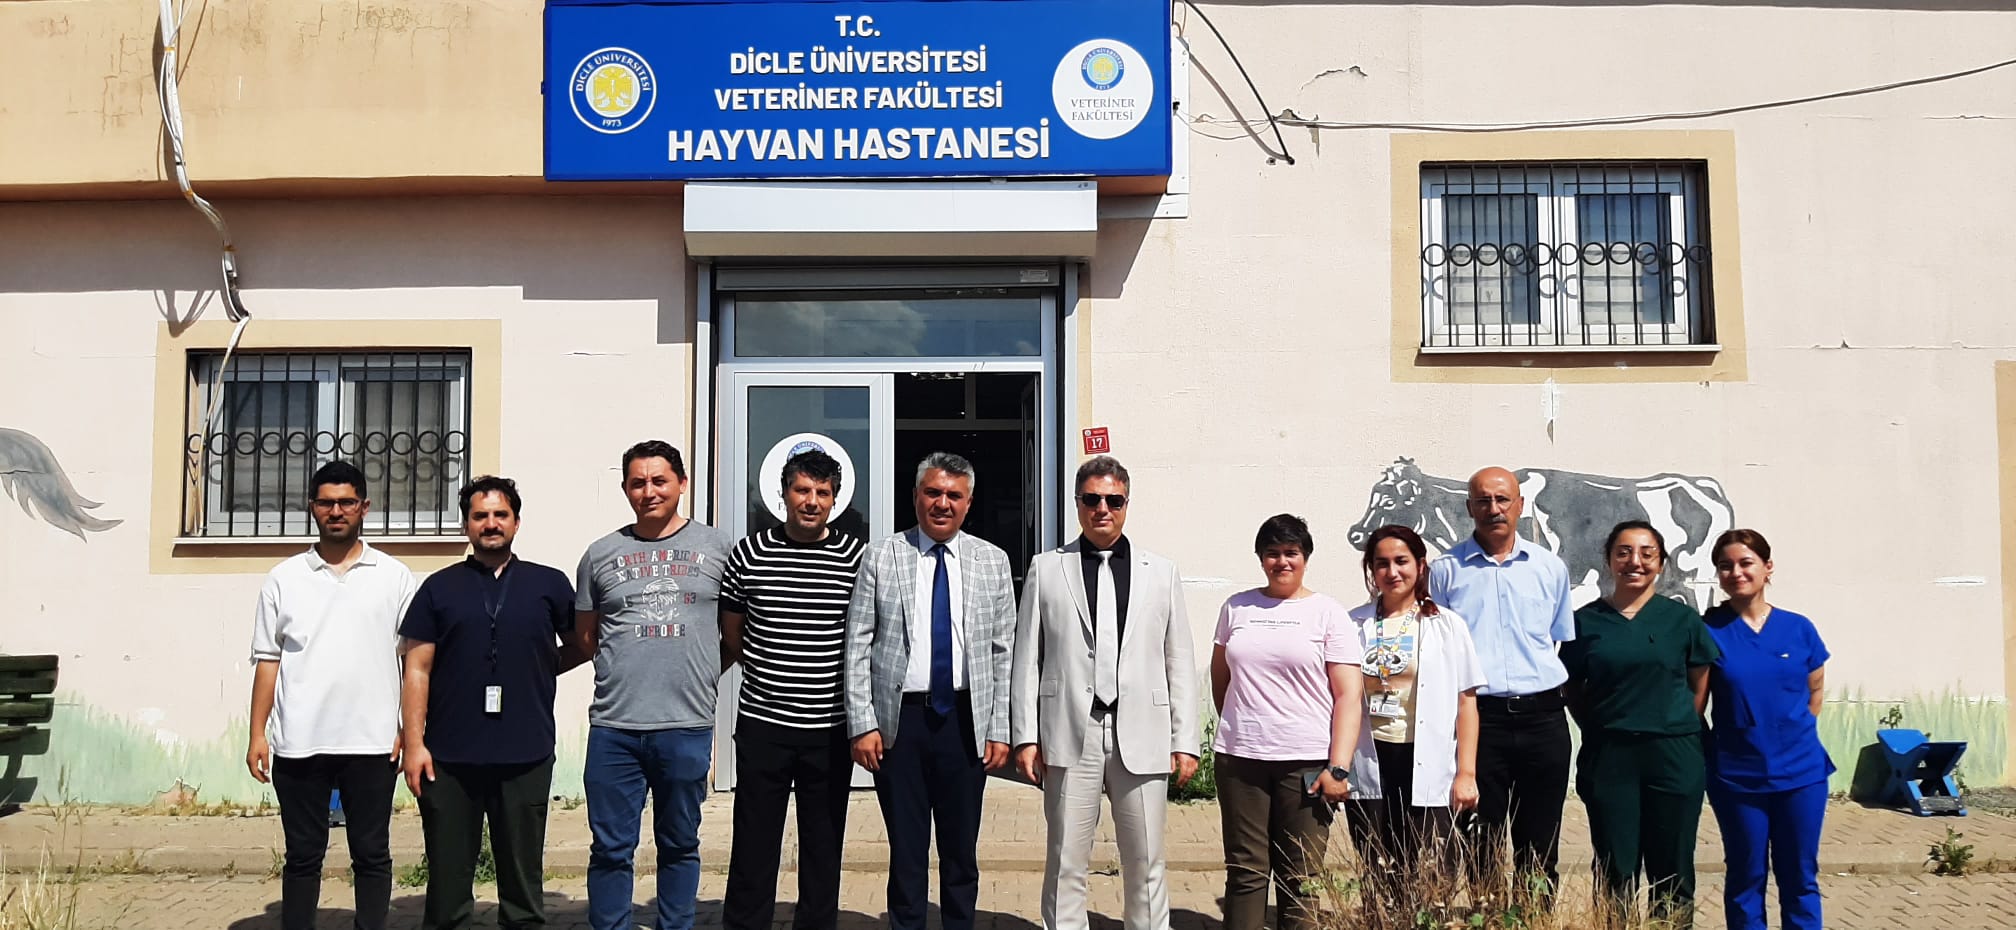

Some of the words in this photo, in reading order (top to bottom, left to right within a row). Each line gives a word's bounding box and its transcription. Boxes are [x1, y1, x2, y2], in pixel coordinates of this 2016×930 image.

[834, 15, 881, 37] T.C.
[730, 46, 805, 74] DİCLE
[810, 44, 986, 74] ÜNİVERSİTESİ
[714, 82, 858, 110] VETERİNER
[864, 80, 1003, 109] FAKÜLTESİ
[1070, 96, 1136, 108] VETERİNER
[602, 119, 622, 127] 1973
[1071, 109, 1134, 121] FAKÜLTESİ
[668, 128, 824, 161] HAYVAN
[834, 117, 1050, 160] HASTANESİ
[1092, 437, 1103, 449] 17
[613, 551, 646, 570] NORTH
[651, 548, 705, 564] AMERICAN
[616, 565, 659, 582] NATIVE
